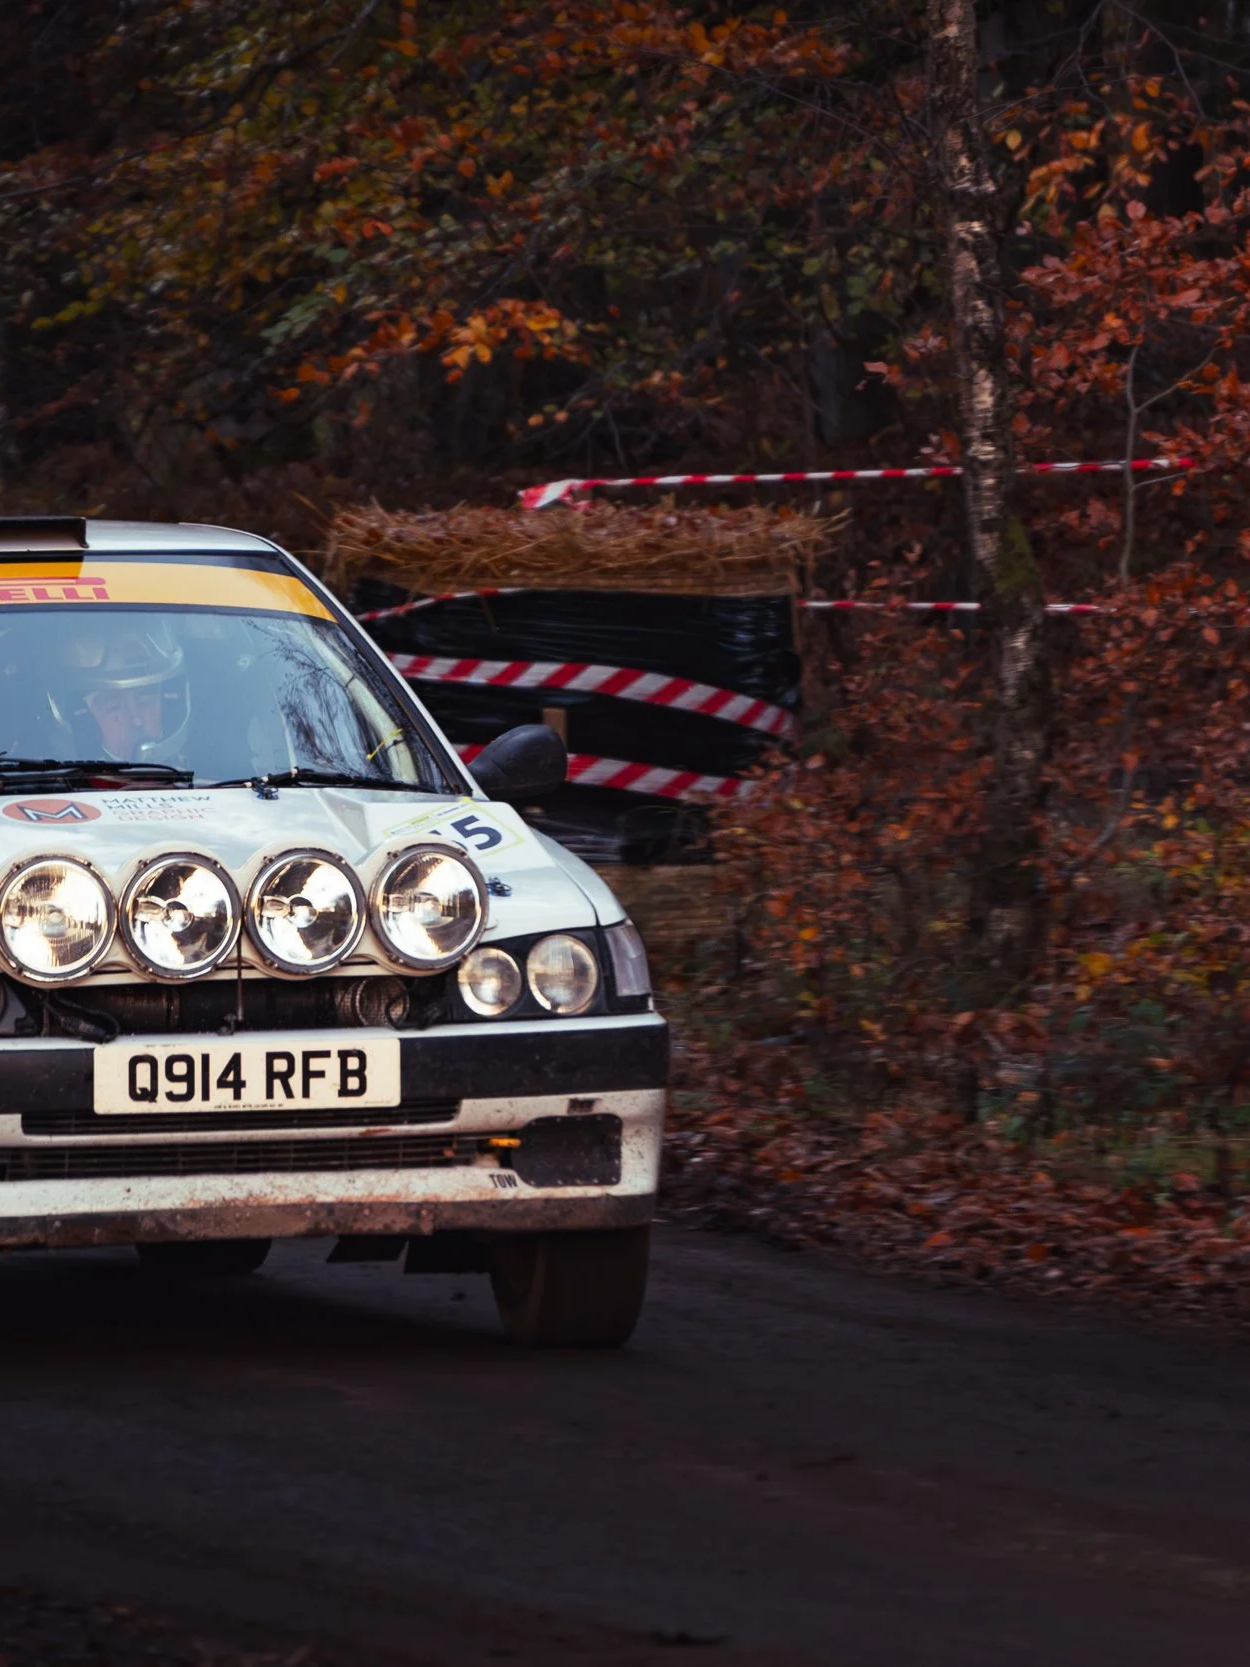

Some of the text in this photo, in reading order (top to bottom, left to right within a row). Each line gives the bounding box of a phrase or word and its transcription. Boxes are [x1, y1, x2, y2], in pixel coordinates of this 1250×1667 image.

[102, 795, 210, 804] MATTHEW
[128, 1049, 367, 1103] Q914 RFB
[488, 1174, 518, 1189] TOW
